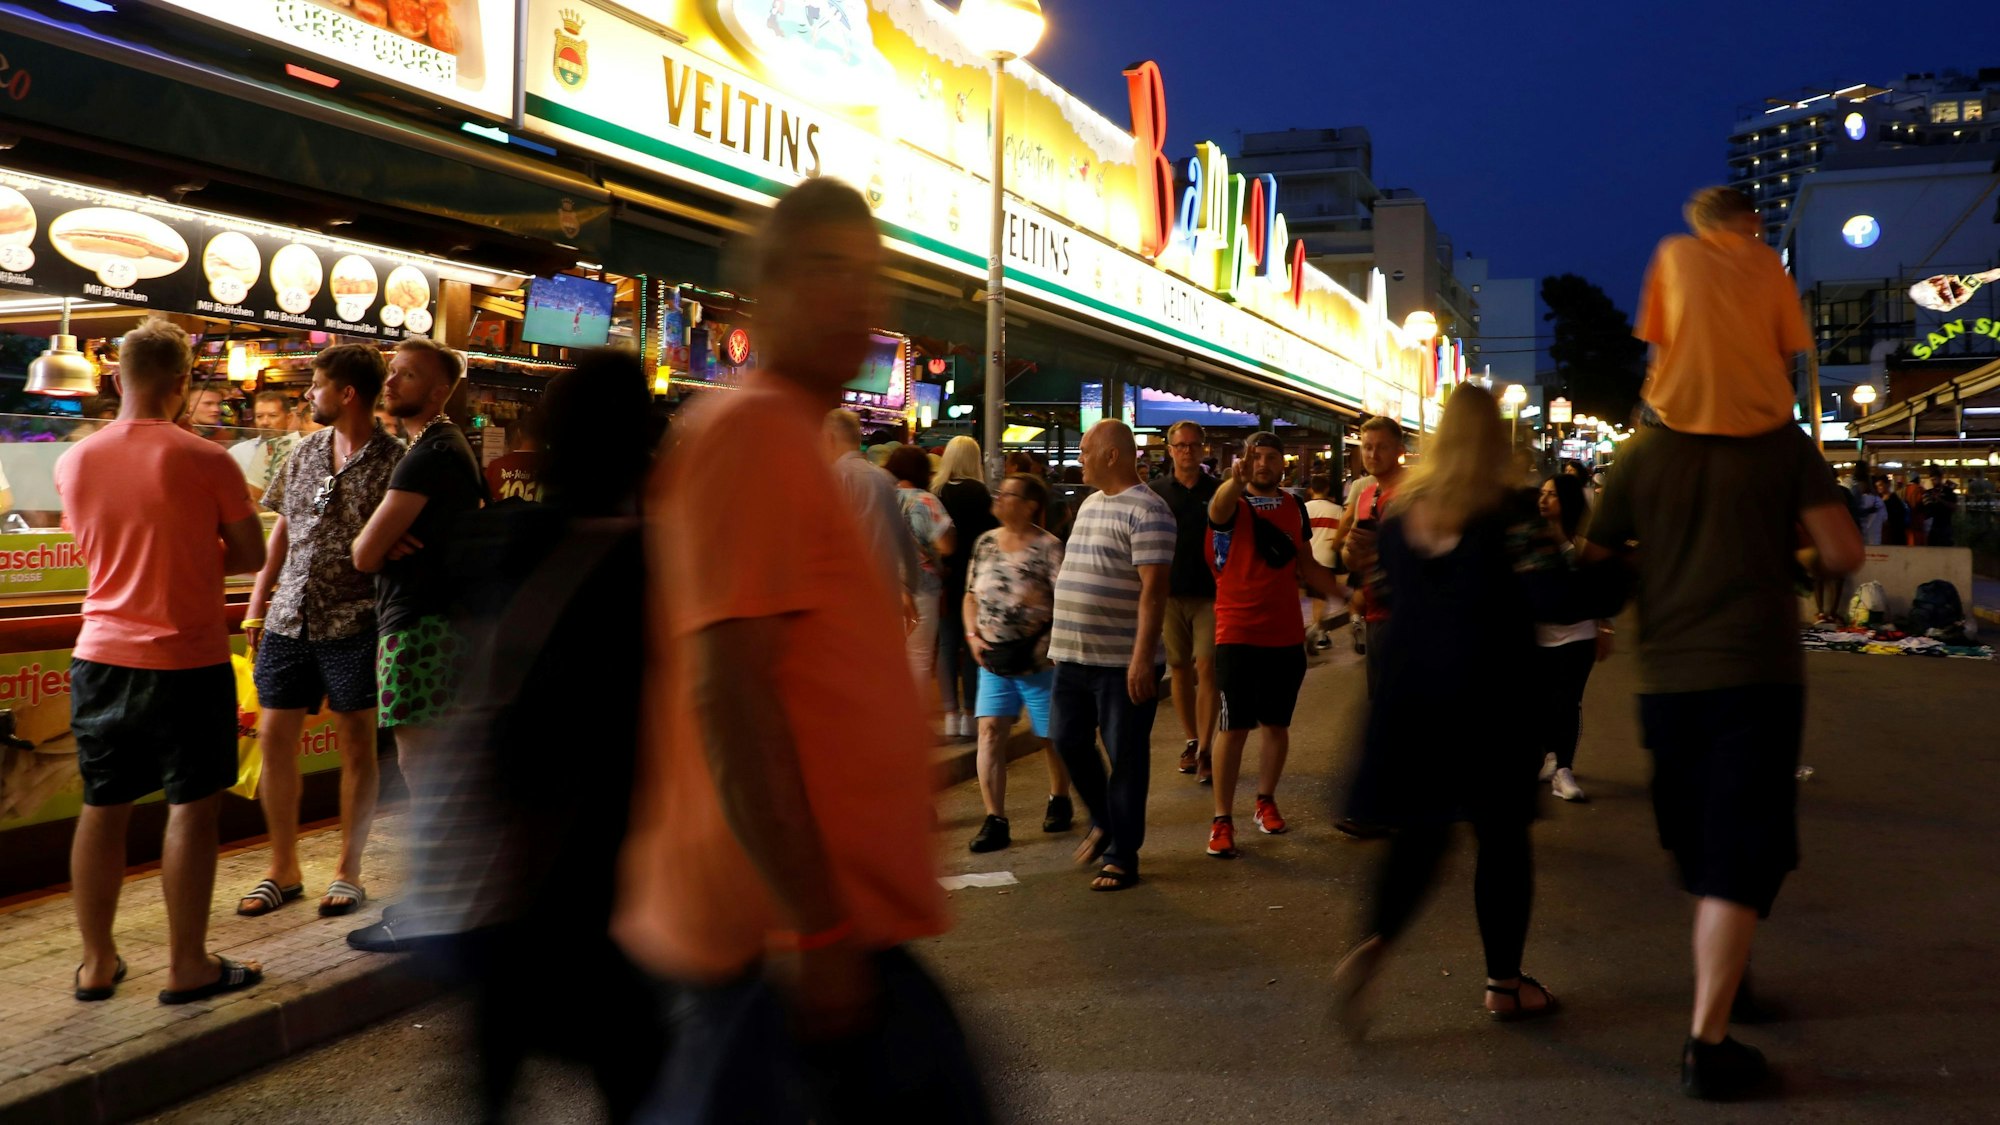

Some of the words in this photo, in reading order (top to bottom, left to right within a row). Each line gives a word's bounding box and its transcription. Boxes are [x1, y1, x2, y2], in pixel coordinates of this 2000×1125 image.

[662, 54, 822, 180] VELTINS
[84, 283, 103, 296] Mit
[103, 286, 149, 302] Brötchen
[197, 300, 213, 311] Mit
[213, 302, 255, 317] Brötchen
[264, 310, 280, 321] Mit
[280, 312, 317, 326] Brötchen
[1912, 318, 1966, 360] SAN
[1973, 317, 2000, 343] SI
[10, 572, 43, 583] SOSSE
